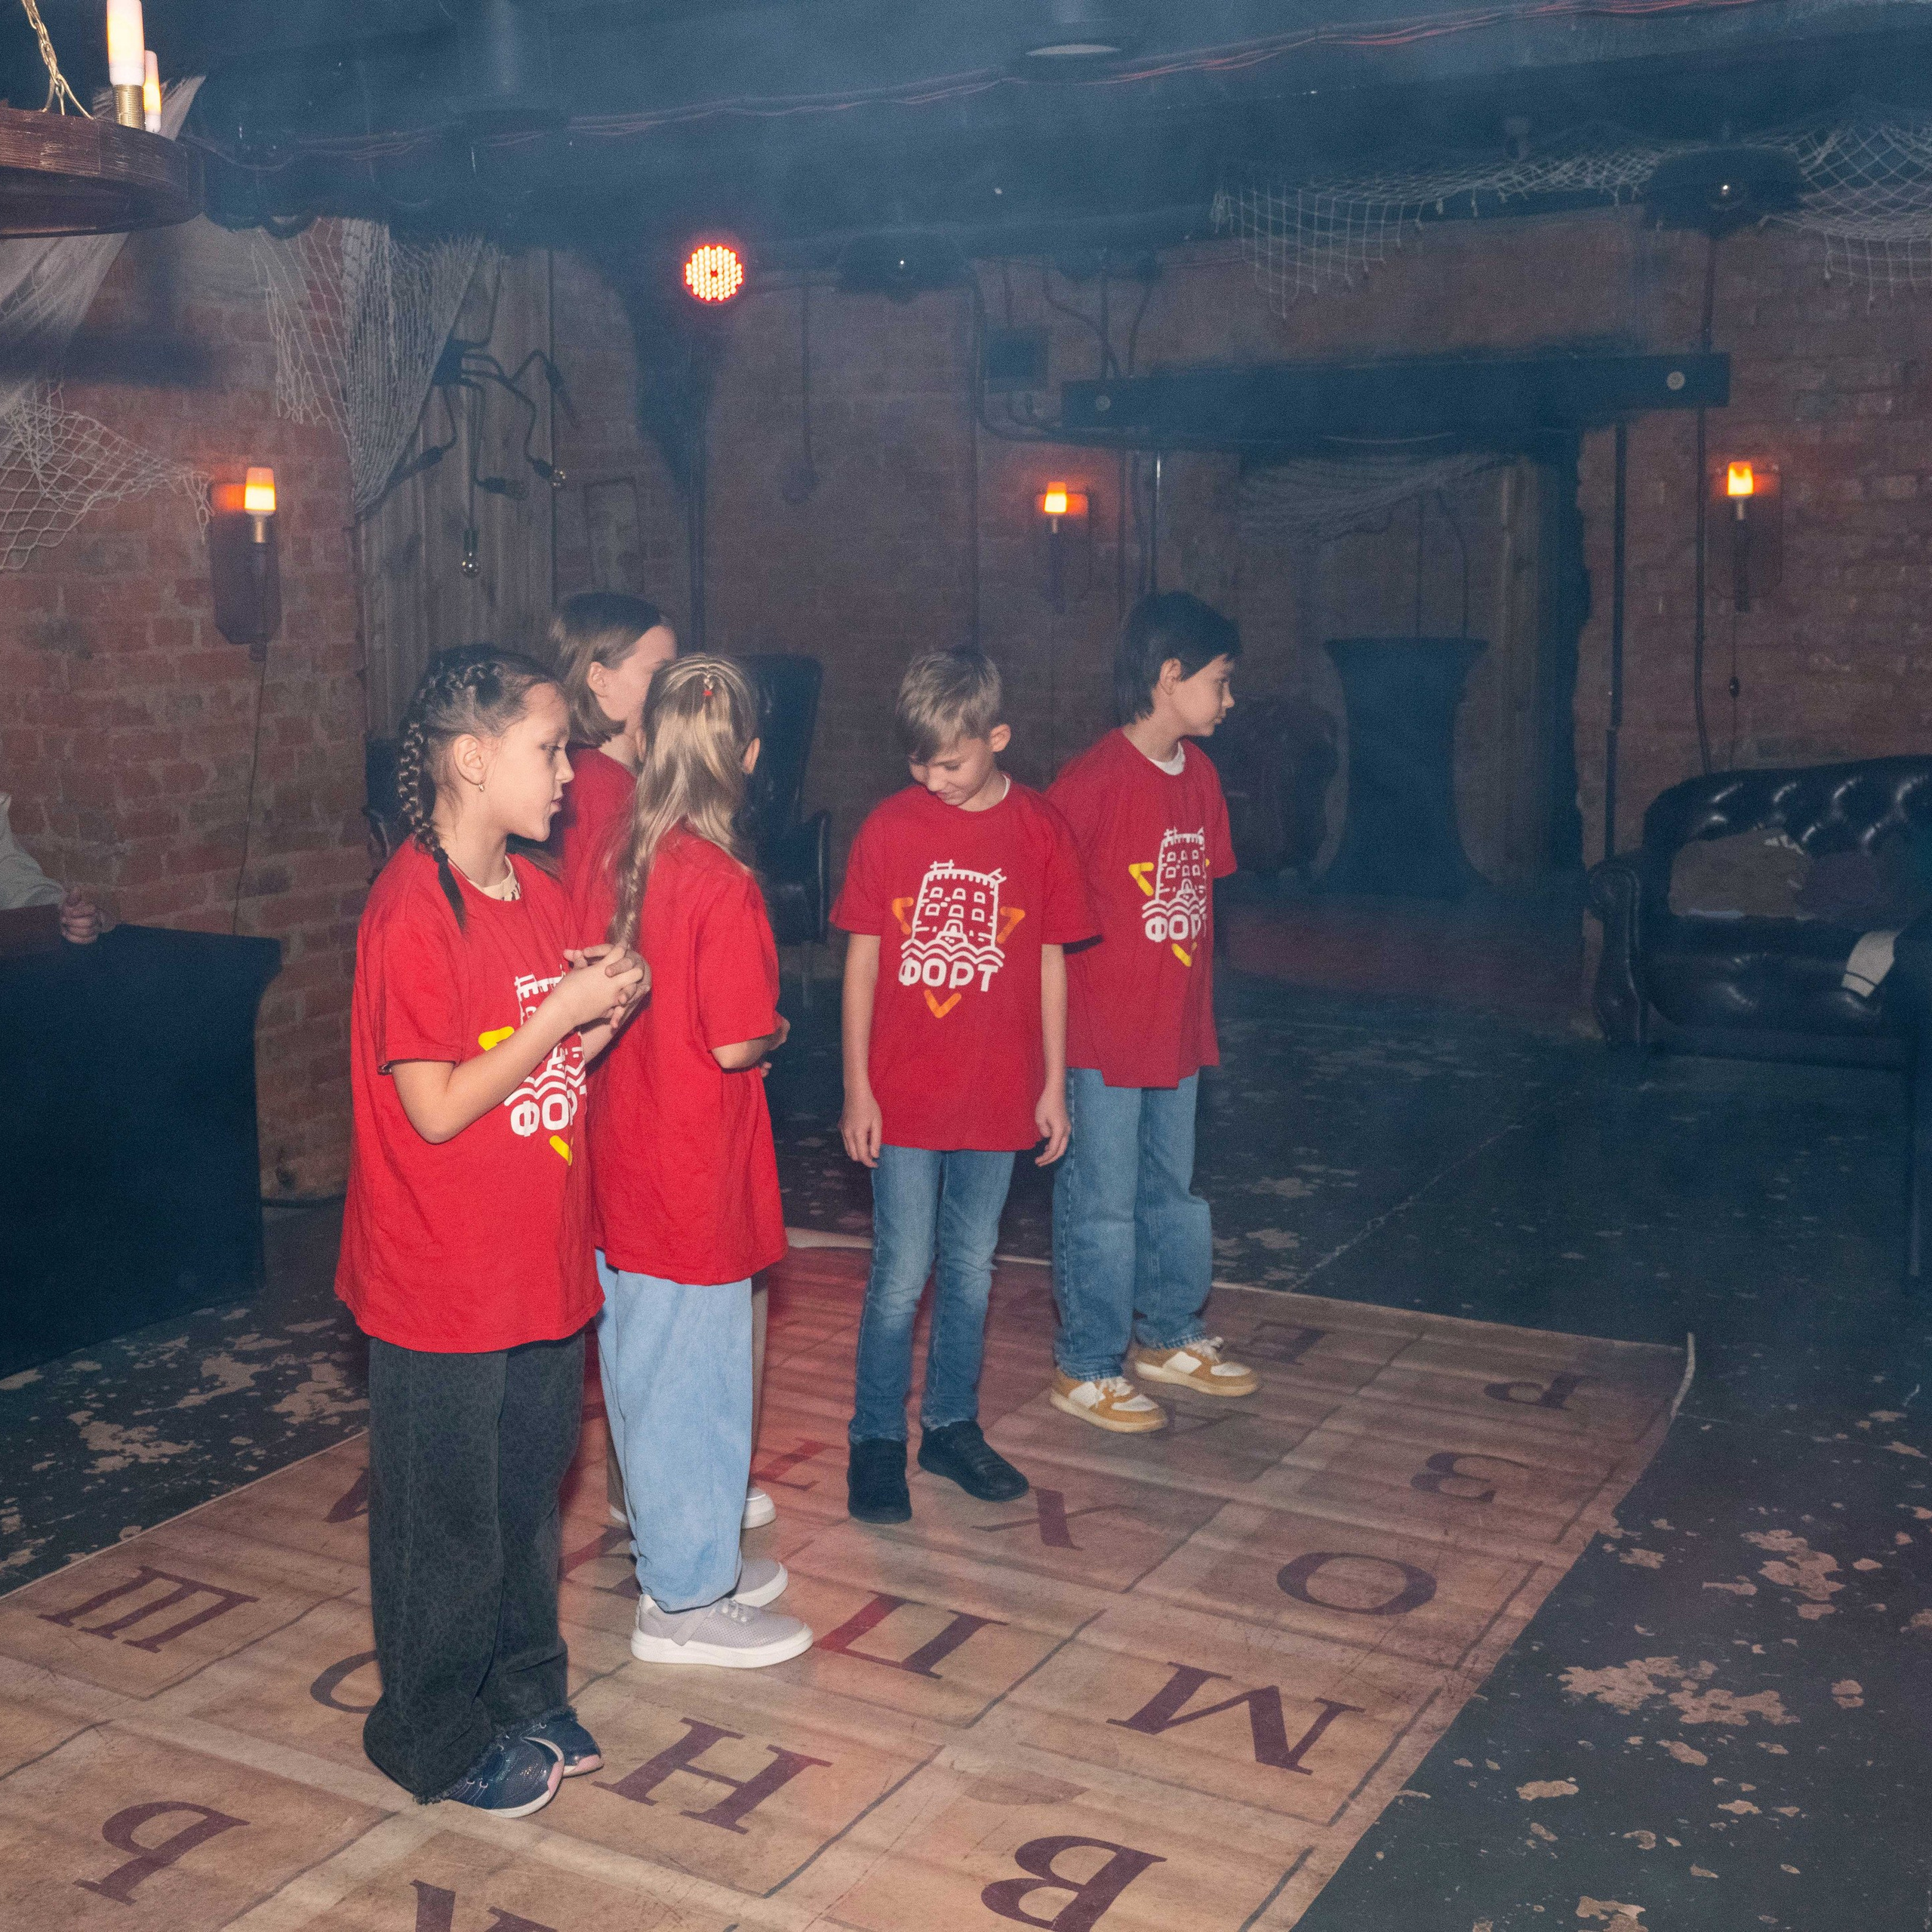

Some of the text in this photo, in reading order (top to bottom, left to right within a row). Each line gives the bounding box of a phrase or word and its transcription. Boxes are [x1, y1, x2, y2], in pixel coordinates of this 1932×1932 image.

[898, 957, 998, 992] ФОРТ
[1411, 1451, 1529, 1504] З
[39, 1566, 259, 1653] Ш
[1277, 1551, 1436, 1615] О
[814, 1592, 1008, 1679] П
[1107, 1661, 1366, 1775] М
[591, 1717, 831, 1834] Н
[980, 1835, 1168, 1932] В
